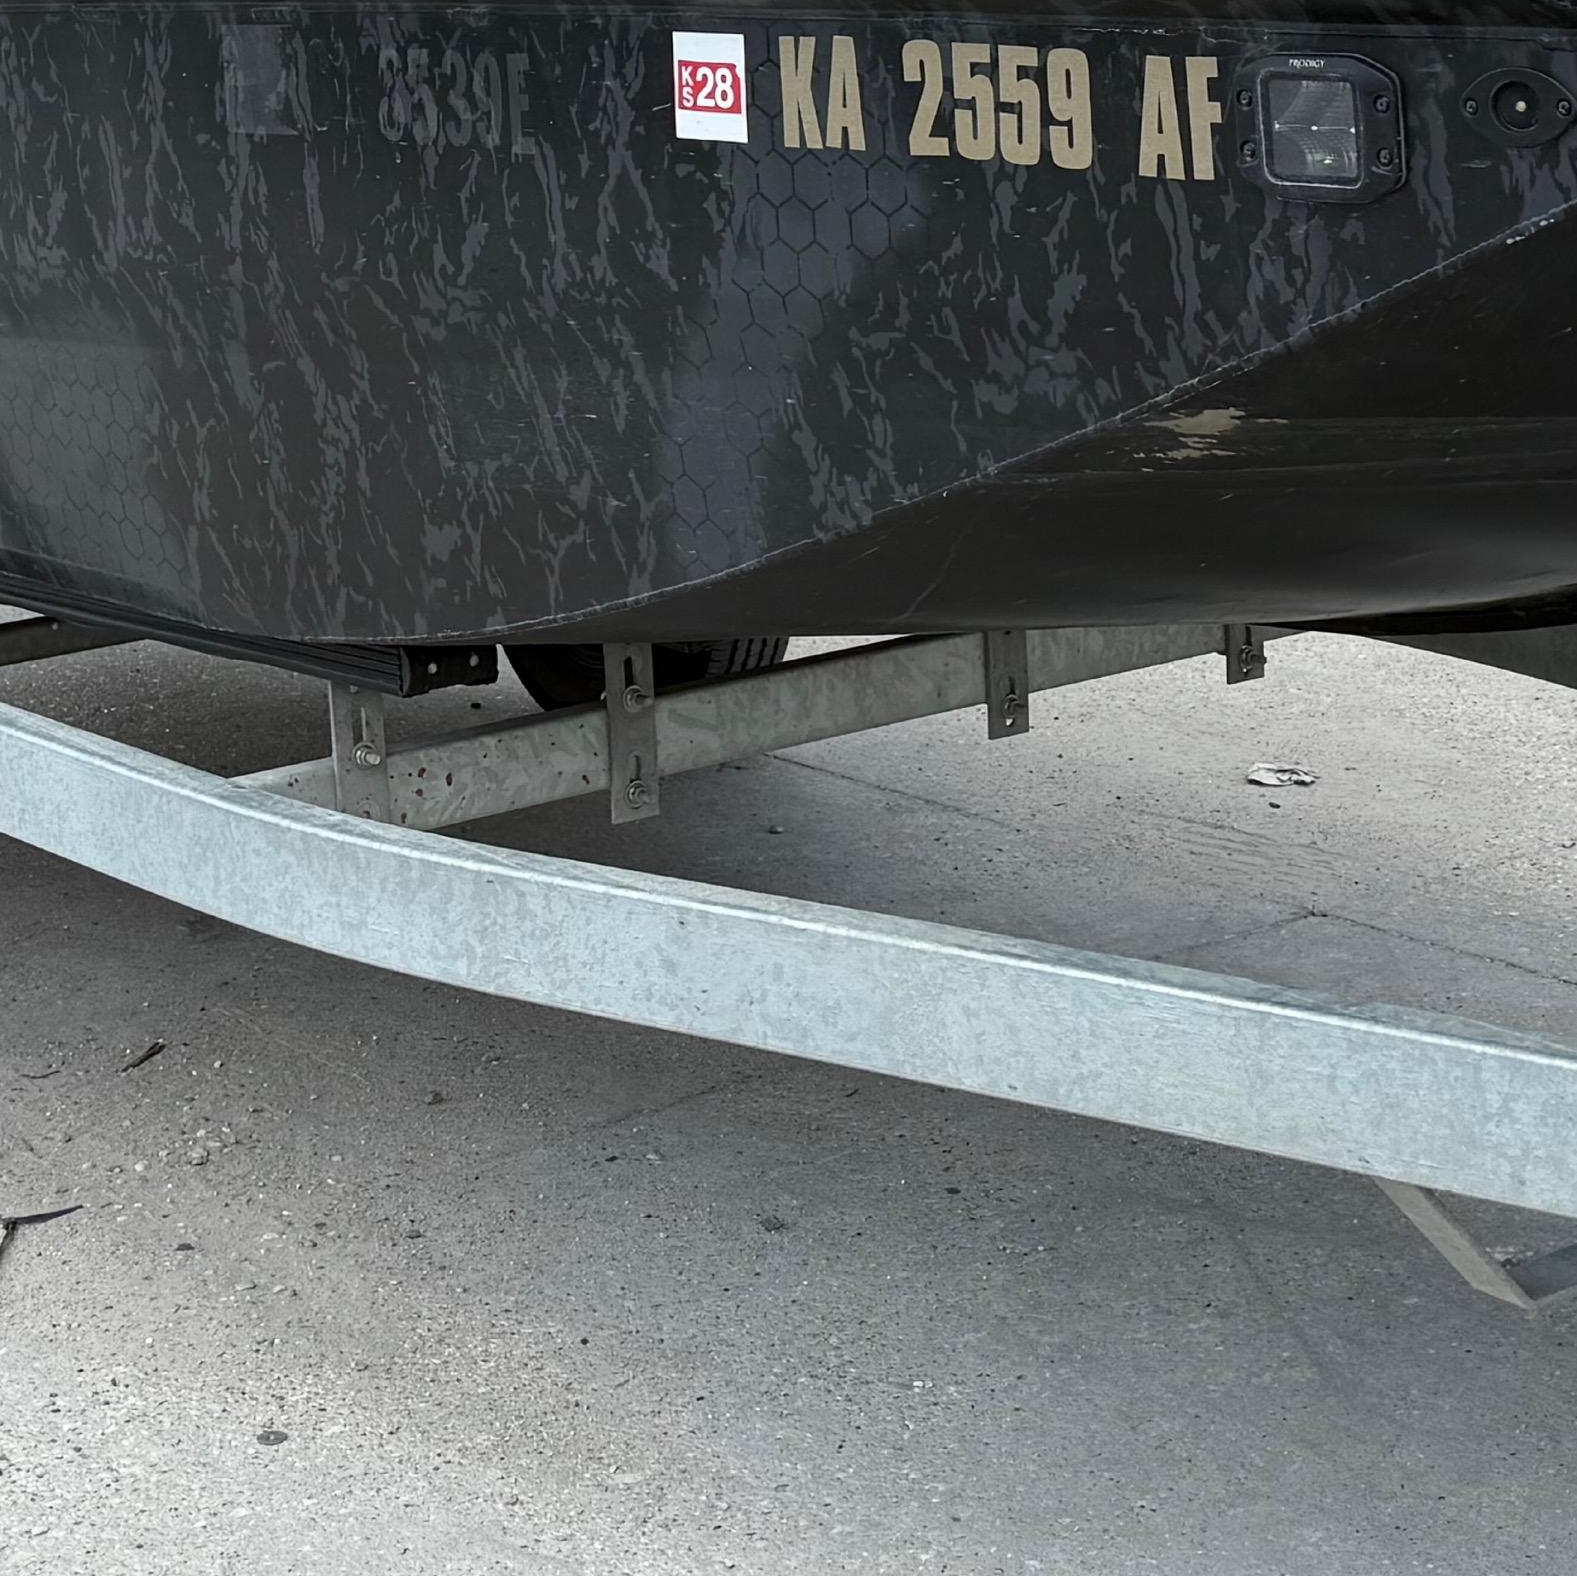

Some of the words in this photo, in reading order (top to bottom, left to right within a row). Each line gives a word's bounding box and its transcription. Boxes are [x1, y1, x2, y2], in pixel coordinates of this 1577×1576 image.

[695, 65, 735, 110] 28
[778, 35, 866, 151] KA
[901, 39, 1094, 170] 2559
[1138, 55, 1222, 181] AF
